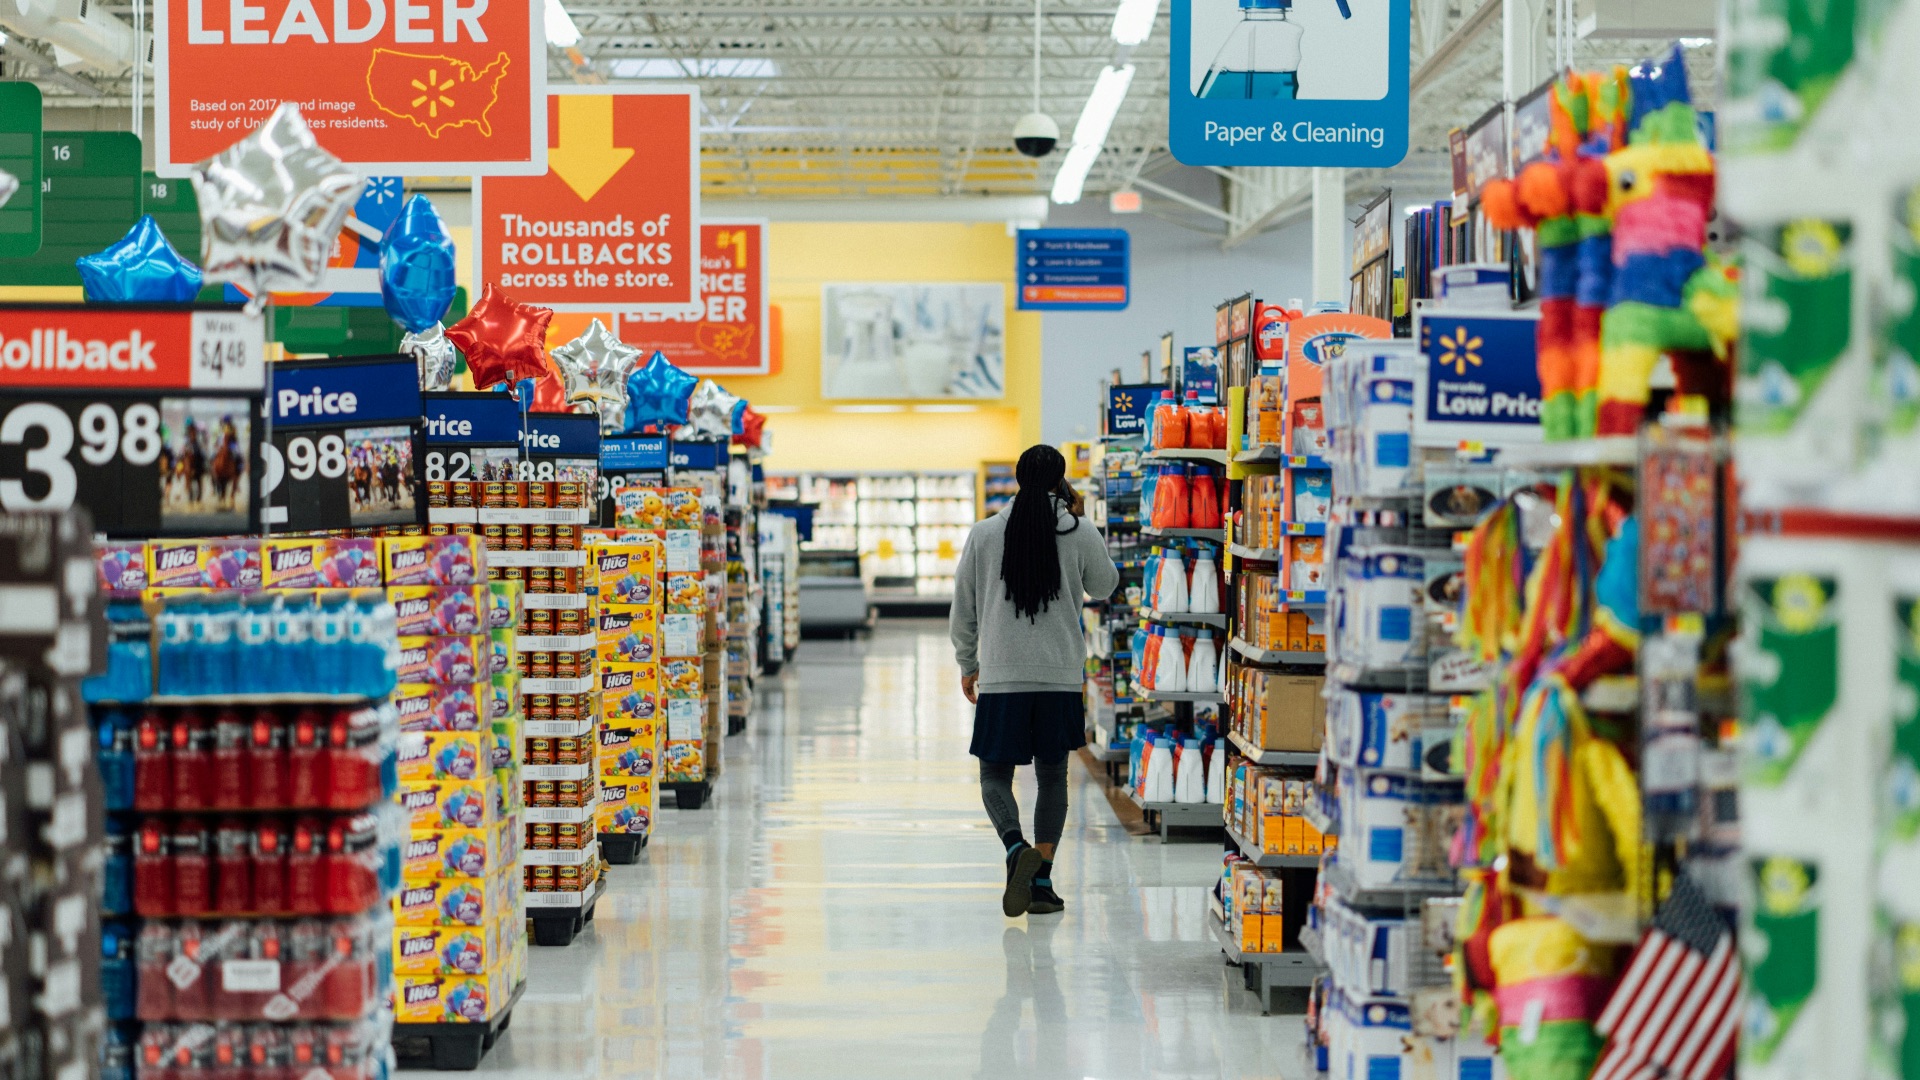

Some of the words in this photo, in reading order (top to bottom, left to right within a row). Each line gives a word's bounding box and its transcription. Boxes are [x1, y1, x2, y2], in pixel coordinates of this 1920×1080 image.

[187, 0, 488, 44] LEADER
[190, 99, 227, 111] Based
[229, 102, 245, 111] on
[249, 99, 276, 111] 2017
[318, 99, 356, 113] image
[190, 118, 223, 132] study
[226, 117, 240, 128] of
[329, 117, 388, 129] residents.
[1204, 121, 1266, 146] Paper
[1270, 122, 1288, 143] &
[1292, 121, 1385, 148] Cleaning
[52, 145, 70, 161] 16
[150, 184, 167, 198] 18
[500, 214, 635, 237] Thousands
[641, 213, 671, 237] of
[501, 243, 672, 265] ROLLBACKS
[717, 229, 747, 270] #1
[501, 271, 567, 287] across
[574, 268, 609, 287] the
[614, 268, 674, 287] store.
[700, 273, 746, 293] RICE
[0, 329, 156, 370] ollback
[278, 387, 357, 417] Price
[1437, 391, 1489, 416] Low
[1115, 418, 1137, 428] Low
[638, 440, 663, 451] meal
[425, 452, 471, 481] 82
[161, 549, 195, 570] HUG
[276, 550, 311, 571] HUG
[396, 551, 426, 569] HUG
[602, 557, 627, 572] HUG
[631, 553, 642, 561] 40
[631, 585, 648, 594] 75%
[400, 600, 429, 618] HUG
[634, 644, 650, 653] 75%
[606, 674, 632, 689] HUG
[635, 671, 646, 679] 40
[401, 698, 429, 715] HUG
[636, 701, 652, 710] 75%
[634, 759, 650, 767] 75%
[601, 787, 626, 802] HUG
[629, 784, 639, 792] 40
[406, 792, 435, 809] HUG
[631, 816, 646, 824] 75%
[407, 841, 437, 859] HUG
[404, 888, 433, 907] HUG
[404, 938, 434, 956] HUG
[409, 985, 438, 1003] HUG
